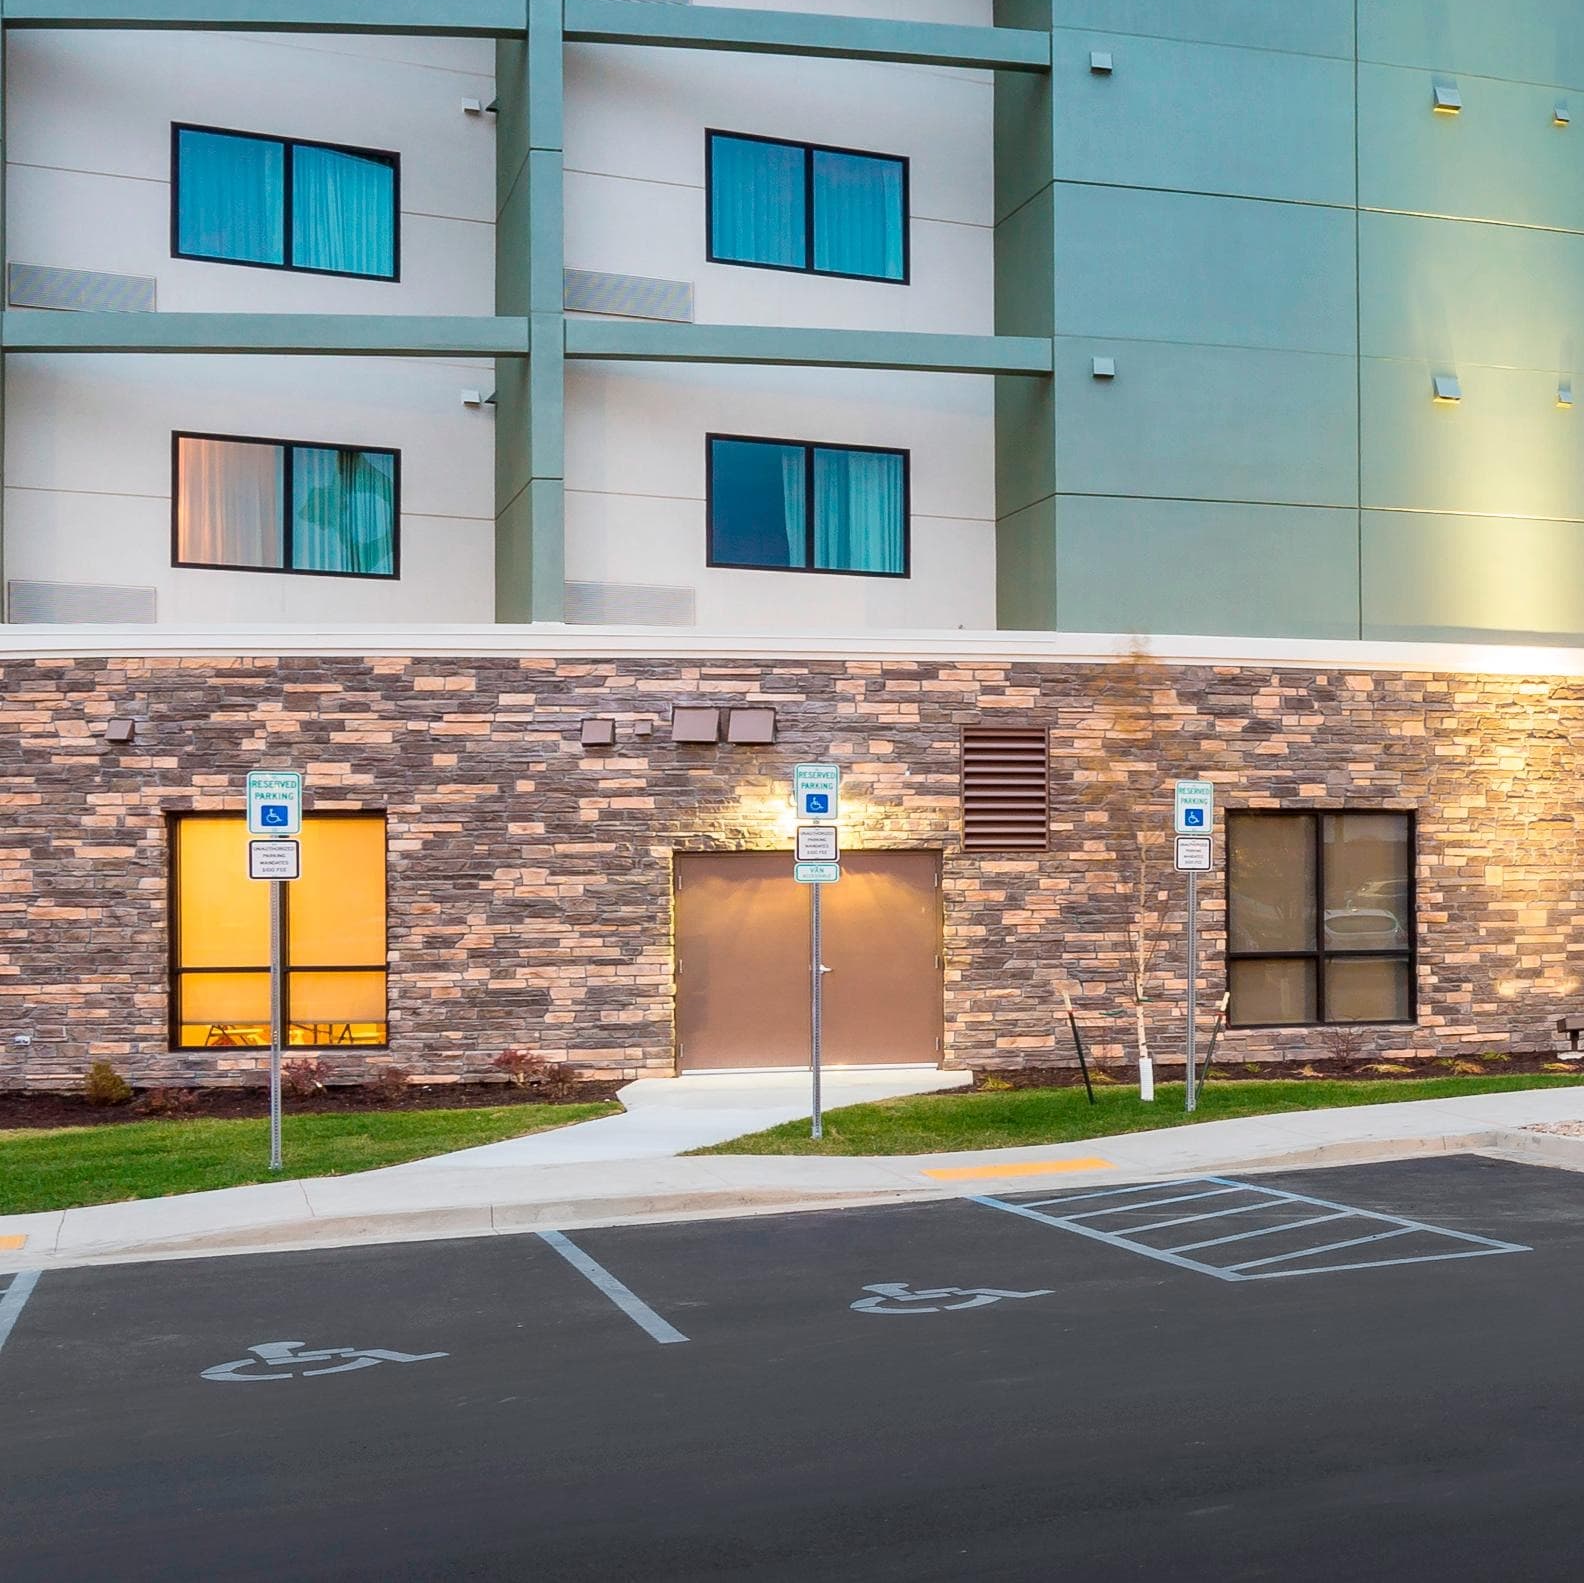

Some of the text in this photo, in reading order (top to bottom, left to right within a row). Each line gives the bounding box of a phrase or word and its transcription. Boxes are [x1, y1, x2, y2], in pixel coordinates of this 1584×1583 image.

[798, 771, 836, 779] RESERVED
[250, 780, 297, 788] RESERVED
[801, 782, 834, 790] PARKING
[1178, 787, 1210, 795] RESERVED
[254, 792, 294, 800] PARKING
